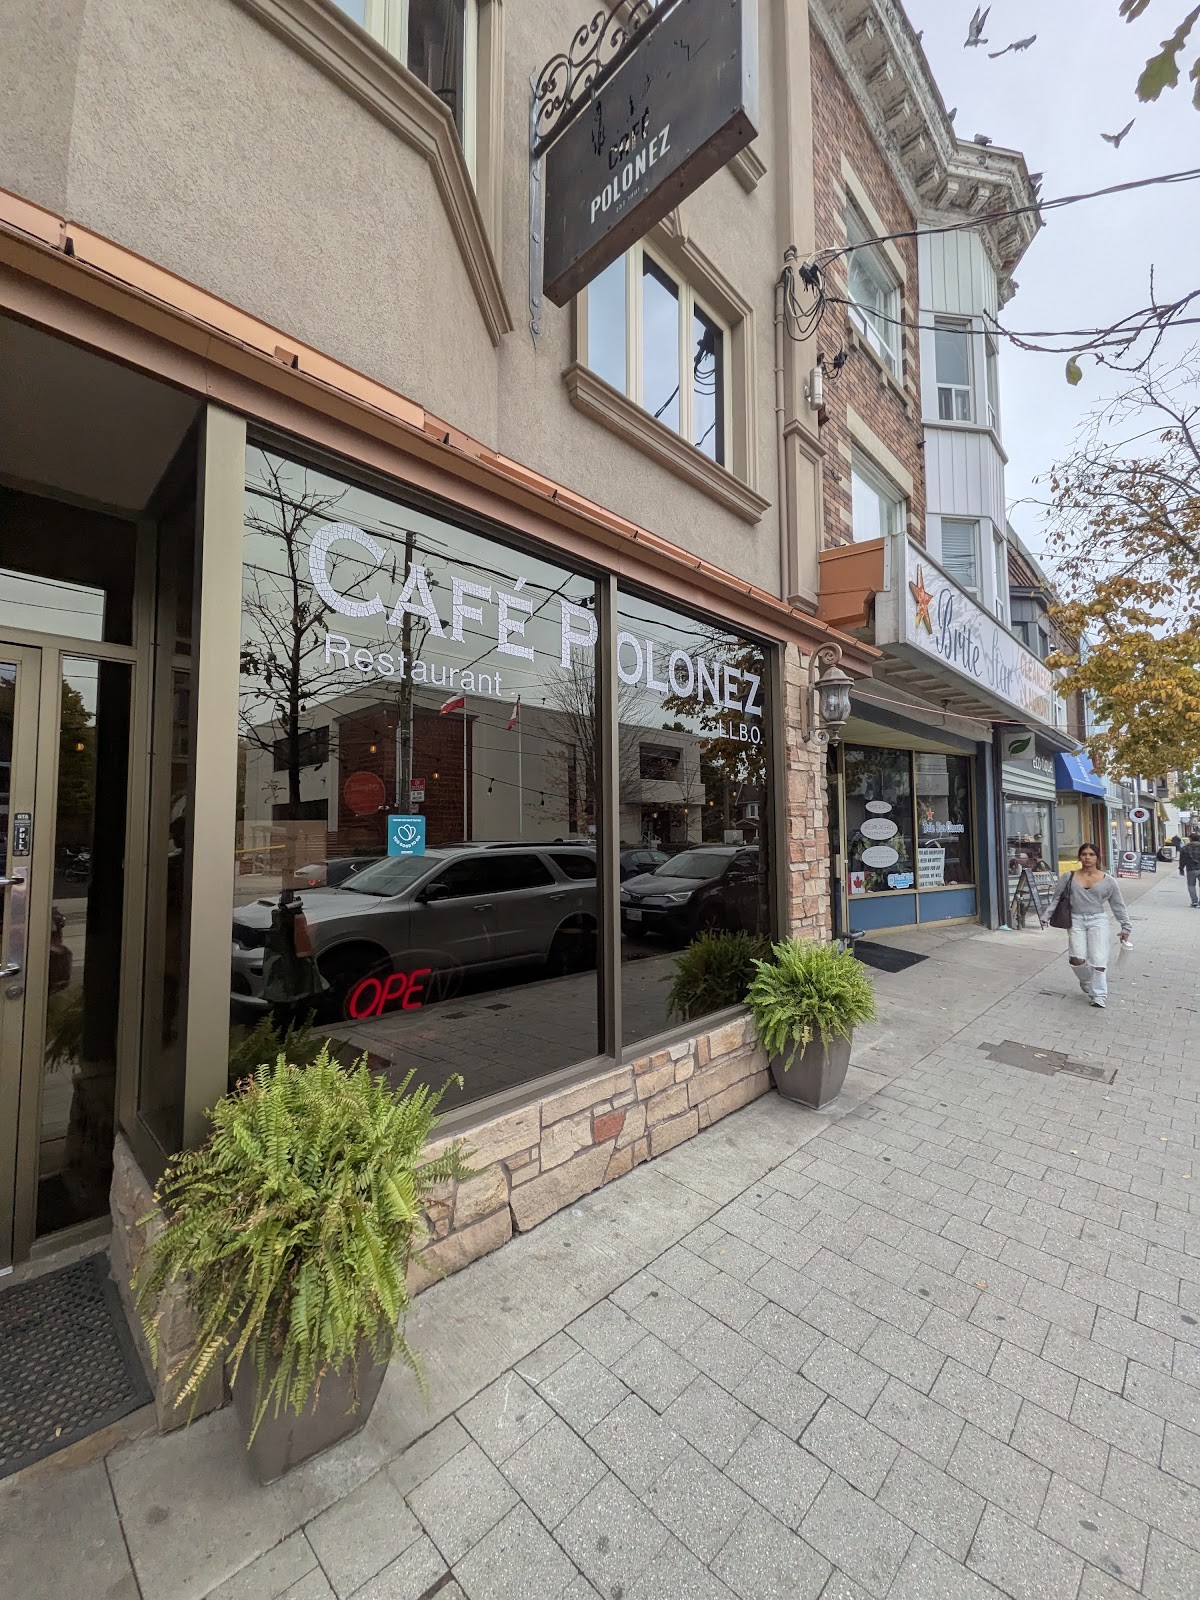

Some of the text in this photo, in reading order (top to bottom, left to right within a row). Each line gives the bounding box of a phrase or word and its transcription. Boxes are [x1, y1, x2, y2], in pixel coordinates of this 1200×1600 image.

[591, 124, 670, 224] POLONEZ
[308, 522, 762, 718] CAFÉ POLONEZ
[324, 633, 502, 697] Restaurant
[936, 588, 1012, 697] Brite Star
